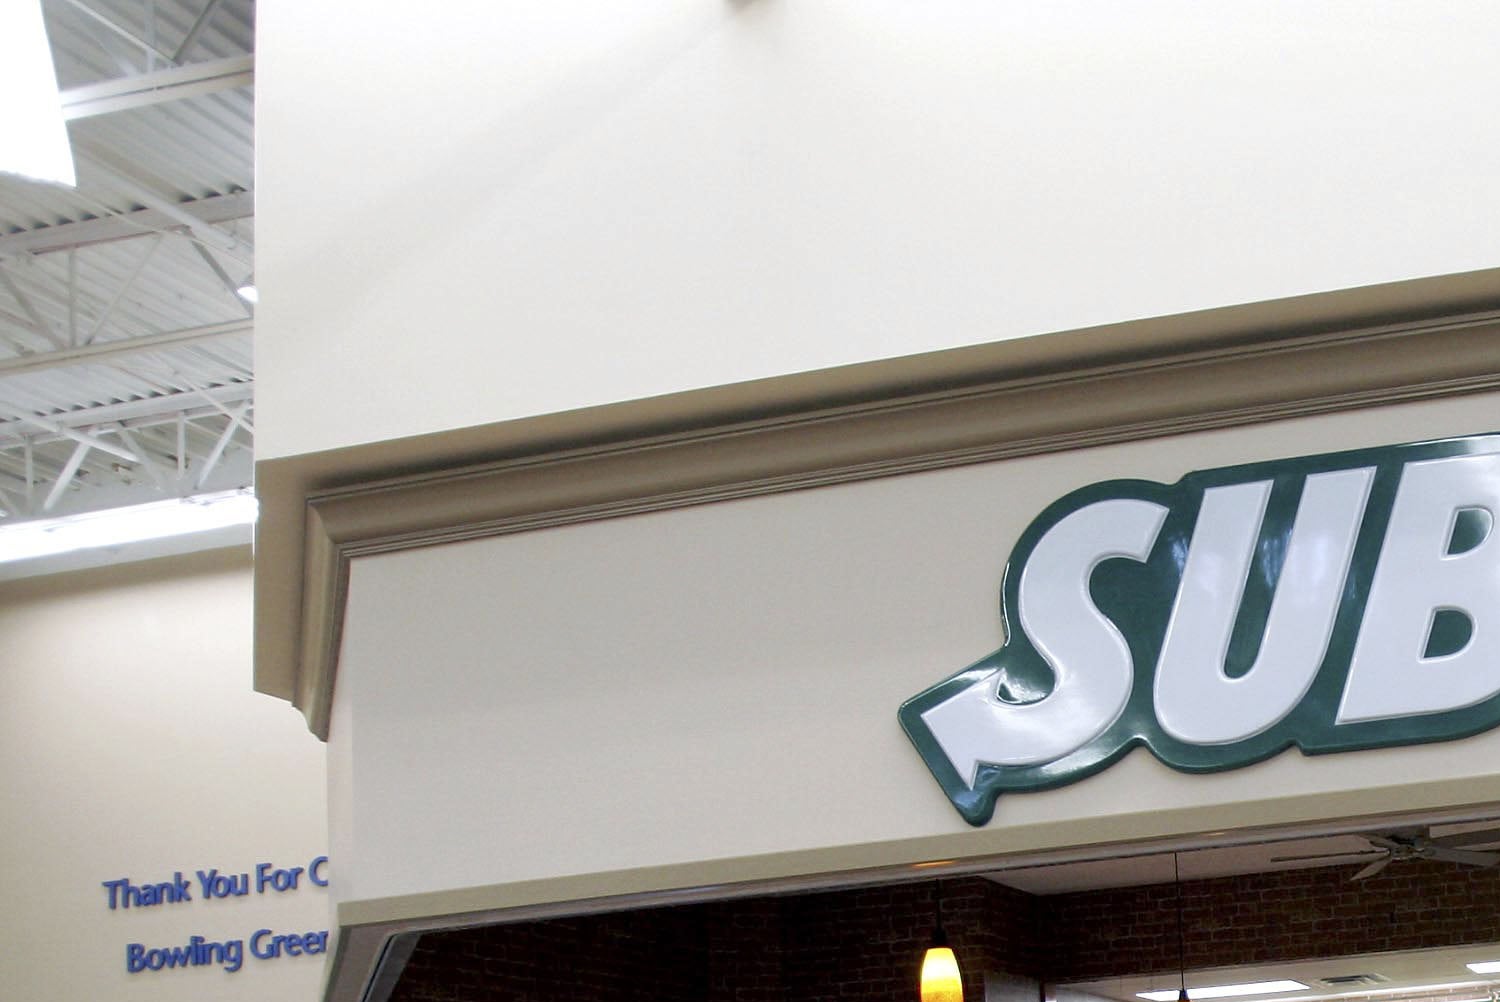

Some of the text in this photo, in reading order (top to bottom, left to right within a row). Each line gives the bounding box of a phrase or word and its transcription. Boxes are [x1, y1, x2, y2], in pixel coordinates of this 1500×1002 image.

[102, 871, 192, 910] Thank
[196, 869, 249, 899] You
[256, 862, 304, 893] For
[126, 935, 243, 973] Bowling
